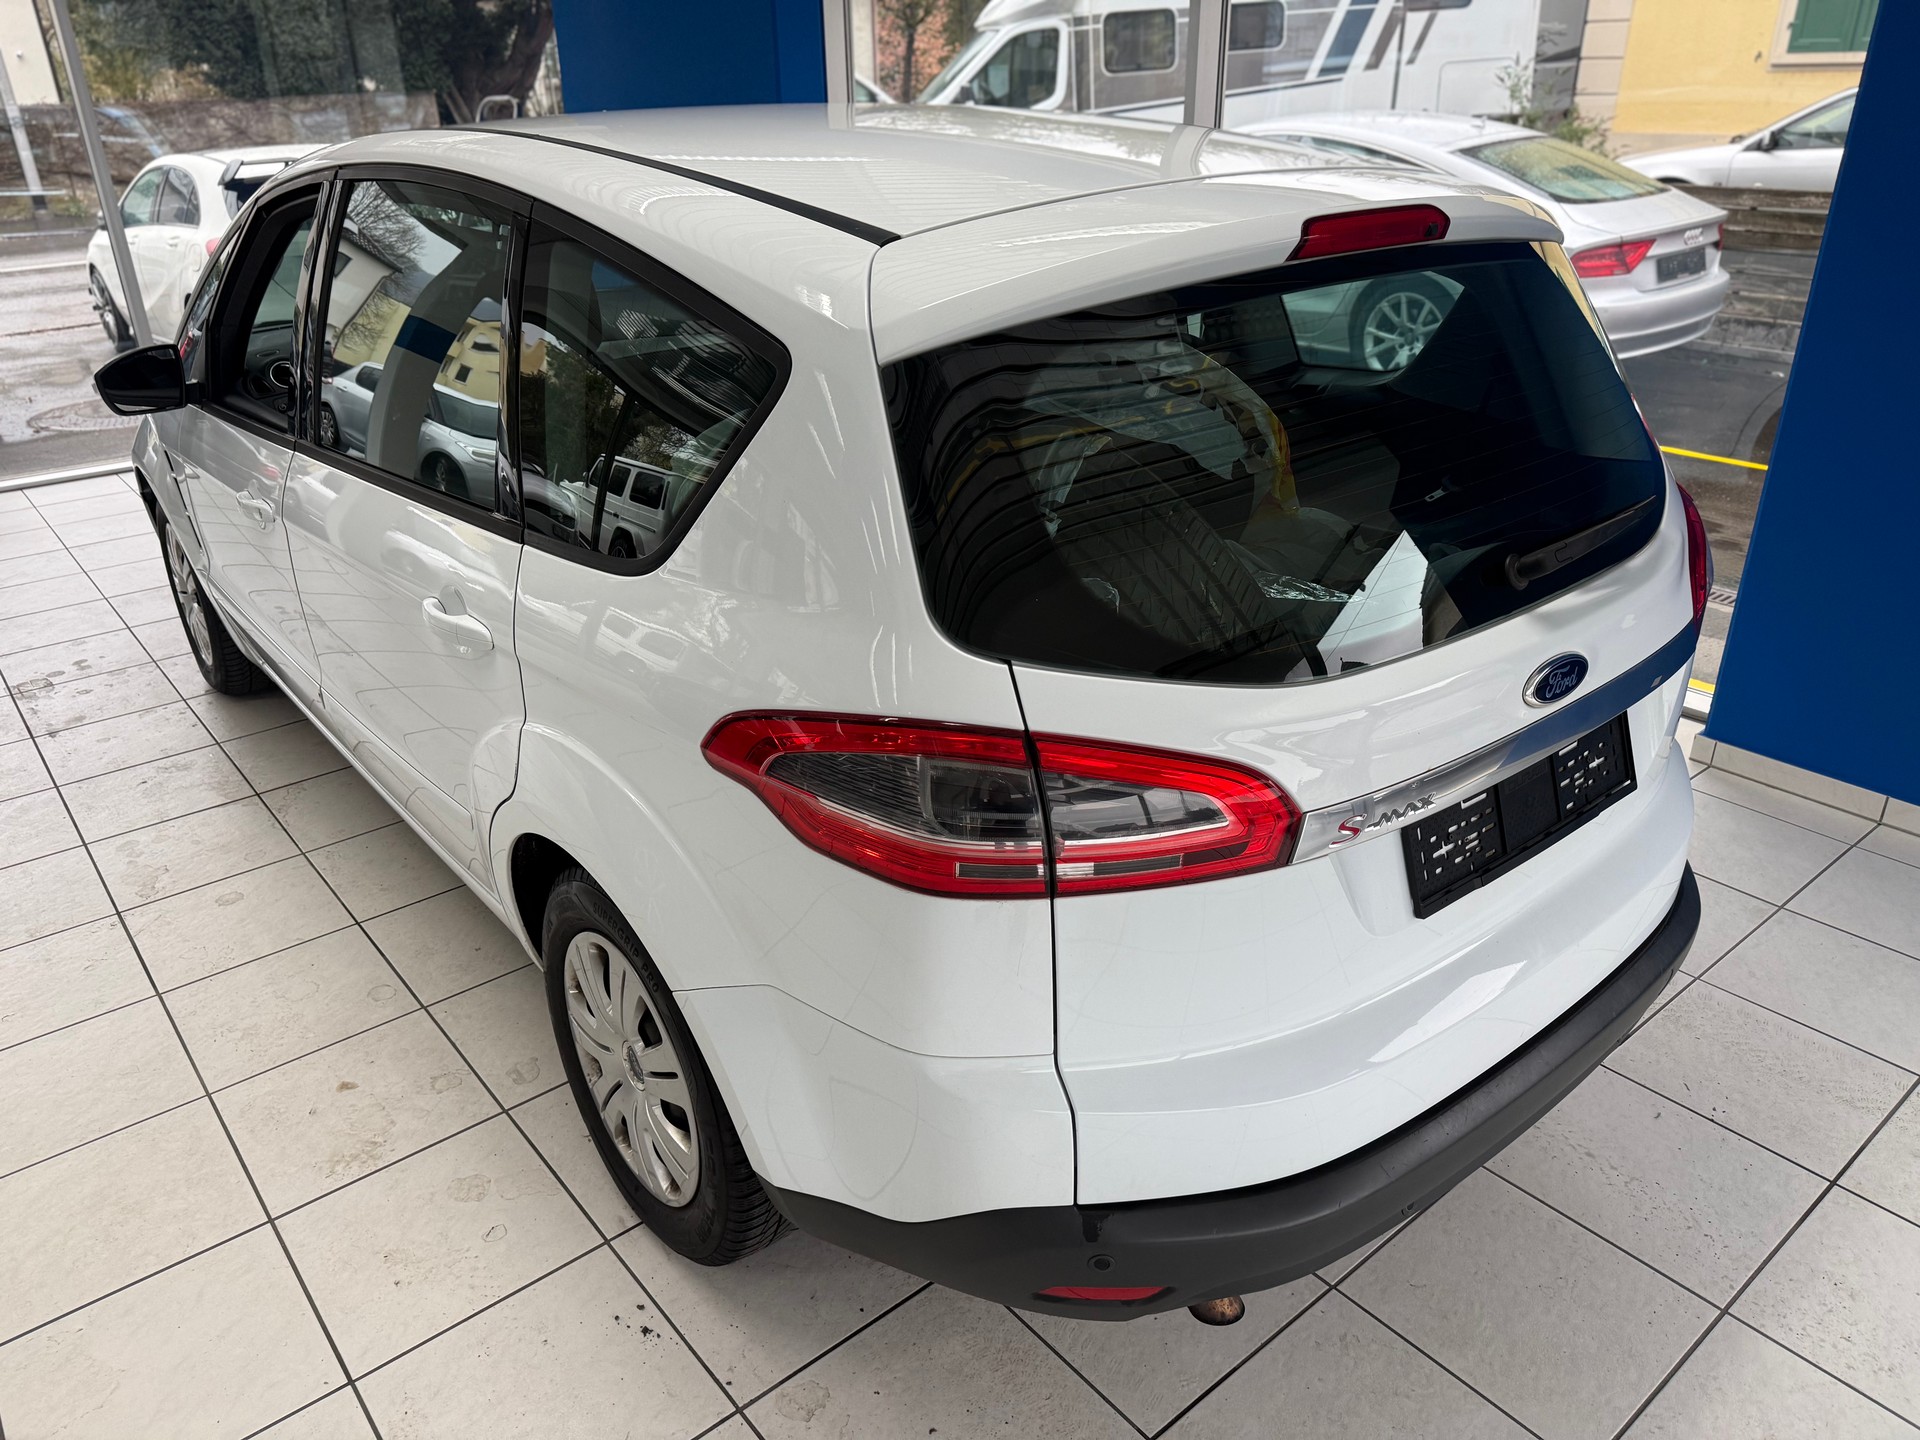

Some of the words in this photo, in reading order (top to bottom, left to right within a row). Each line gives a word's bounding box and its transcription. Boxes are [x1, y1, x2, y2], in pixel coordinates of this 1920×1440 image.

[1545, 665, 1579, 699] Ford
[1328, 792, 1437, 849] S-MAX
[592, 901, 640, 959] SUPERGRIP
[641, 962, 660, 993] PRO
